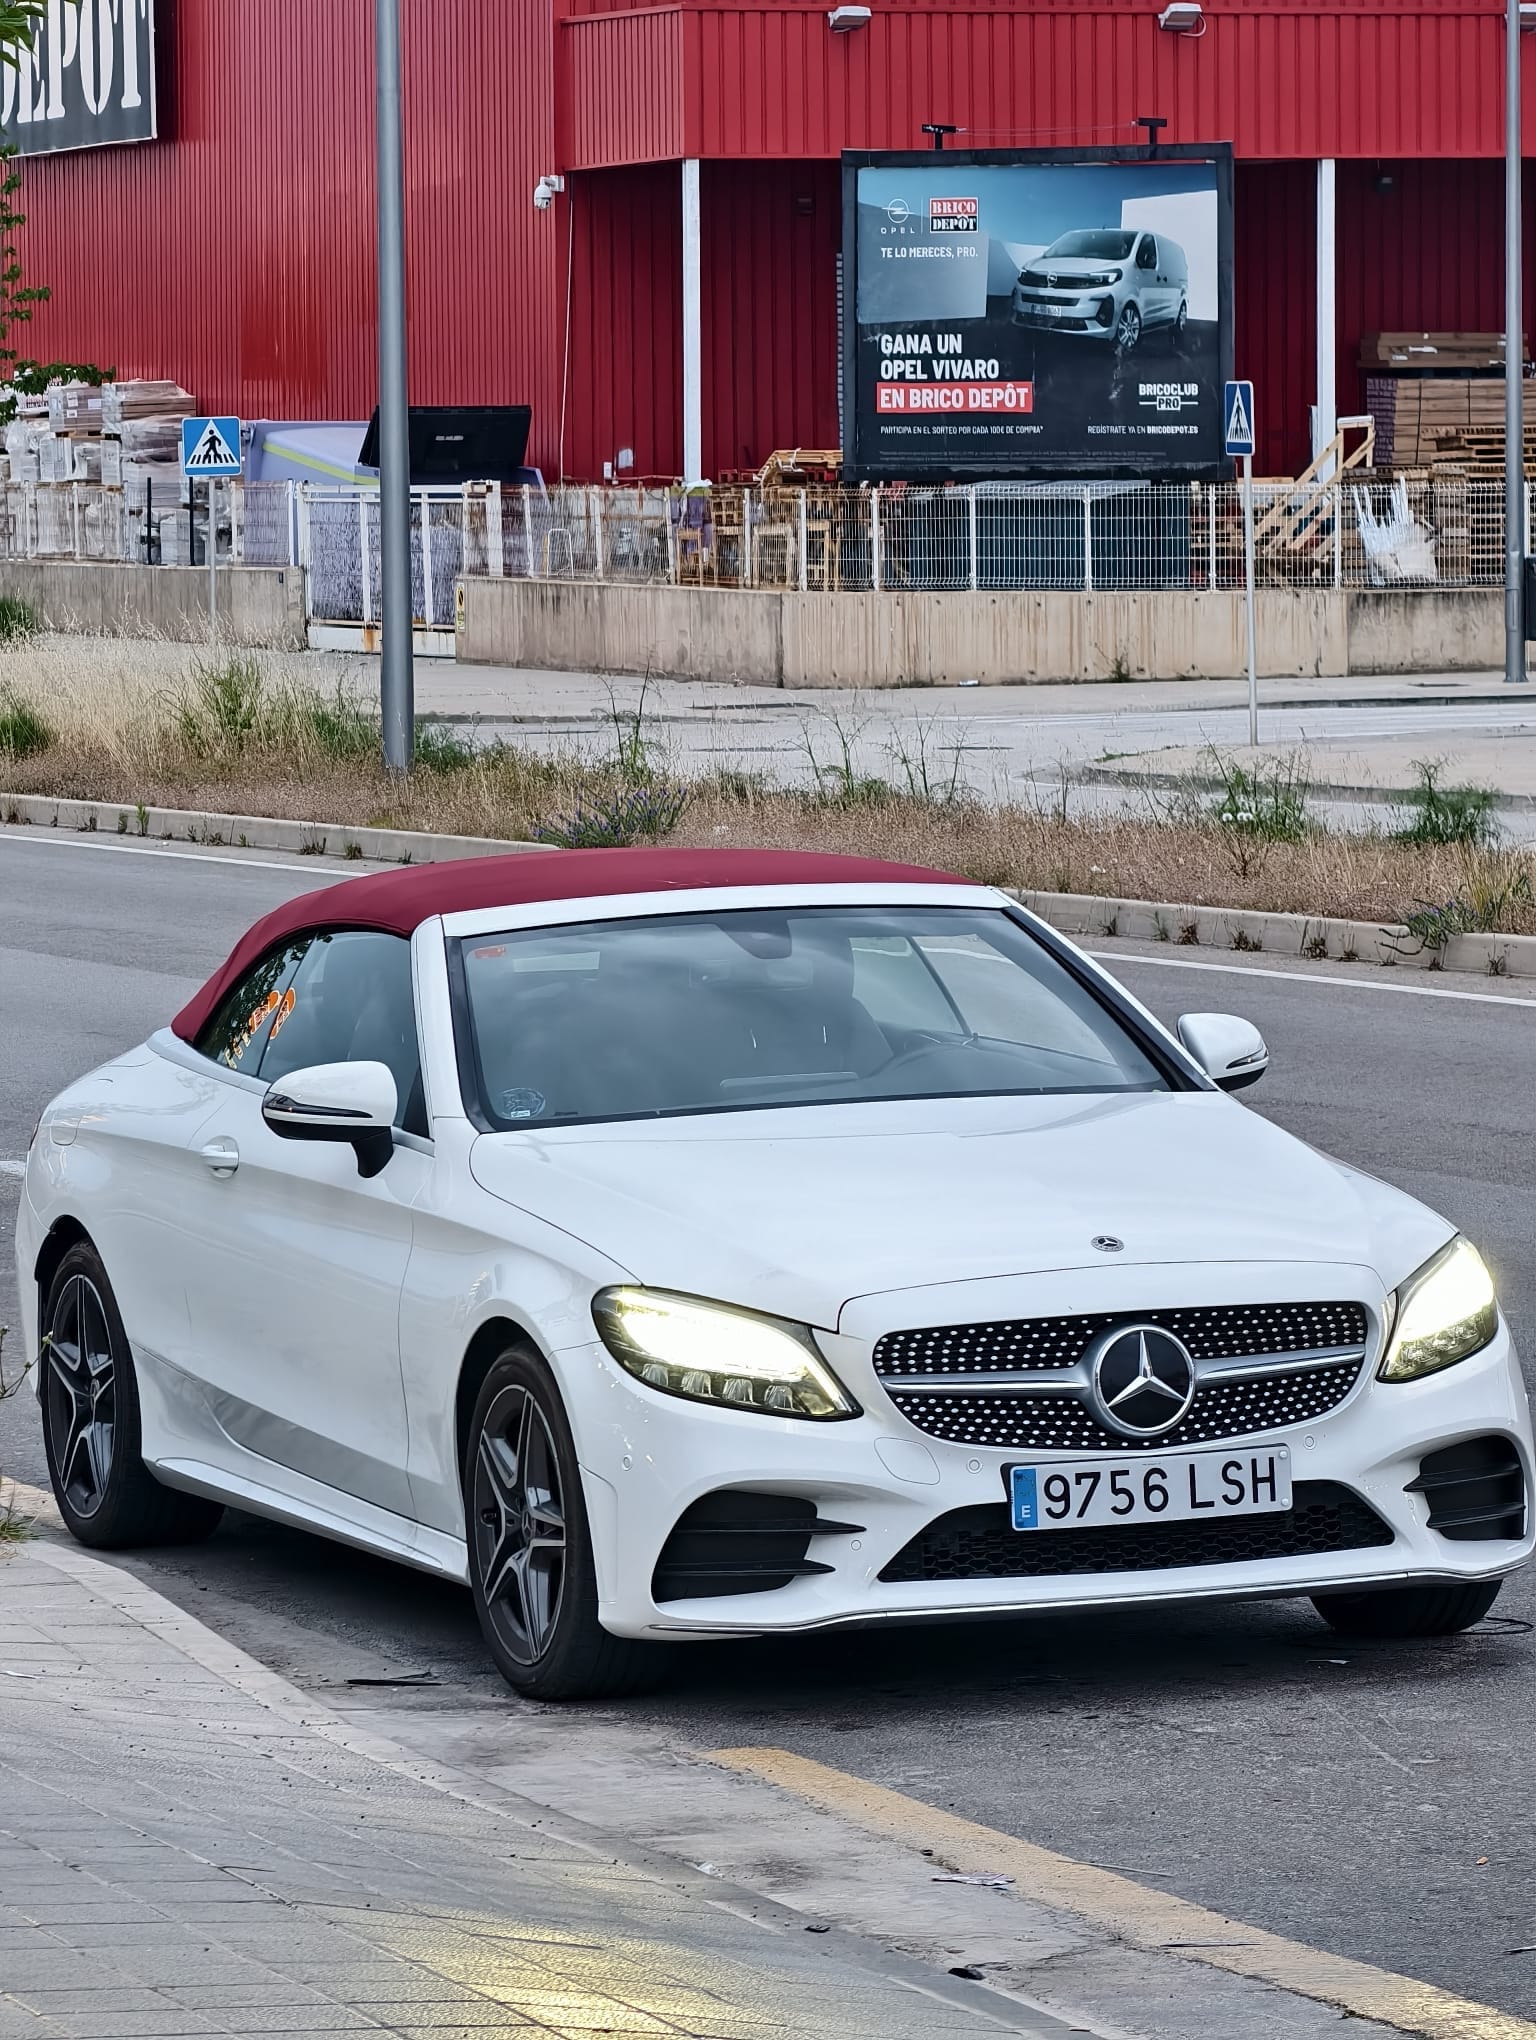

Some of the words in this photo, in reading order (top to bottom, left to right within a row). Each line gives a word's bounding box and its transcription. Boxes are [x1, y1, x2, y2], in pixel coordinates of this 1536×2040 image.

[932, 201, 976, 214] BRICO
[881, 247, 893, 258] TE
[895, 247, 907, 258] LO
[909, 246, 954, 259] MERECES,
[957, 246, 978, 257] PRO.
[880, 334, 933, 354] GANA
[937, 334, 963, 354] UN
[880, 359, 928, 380] OPEL
[932, 358, 1000, 380] VIVARO
[880, 388, 905, 409] EN
[909, 388, 964, 409] BRICO
[968, 383, 1029, 408] DEPÔT
[1139, 383, 1199, 396] BRICOCLUB
[1158, 398, 1180, 409] PRO
[880, 425, 912, 434] PARTICIPA
[913, 425, 922, 434] EN
[923, 425, 931, 434] EL
[932, 425, 958, 434] SORTEO
[959, 425, 971, 434] POR
[972, 425, 989, 434] CADA
[1006, 425, 1014, 434] DE
[1088, 424, 1126, 434] REGÍSTRATE
[1127, 425, 1136, 434] YA
[1137, 425, 1146, 434] EN
[1043, 1467, 1170, 1520] 9756
[1189, 1456, 1276, 1510] LSH
[1021, 1504, 1031, 1518] E
